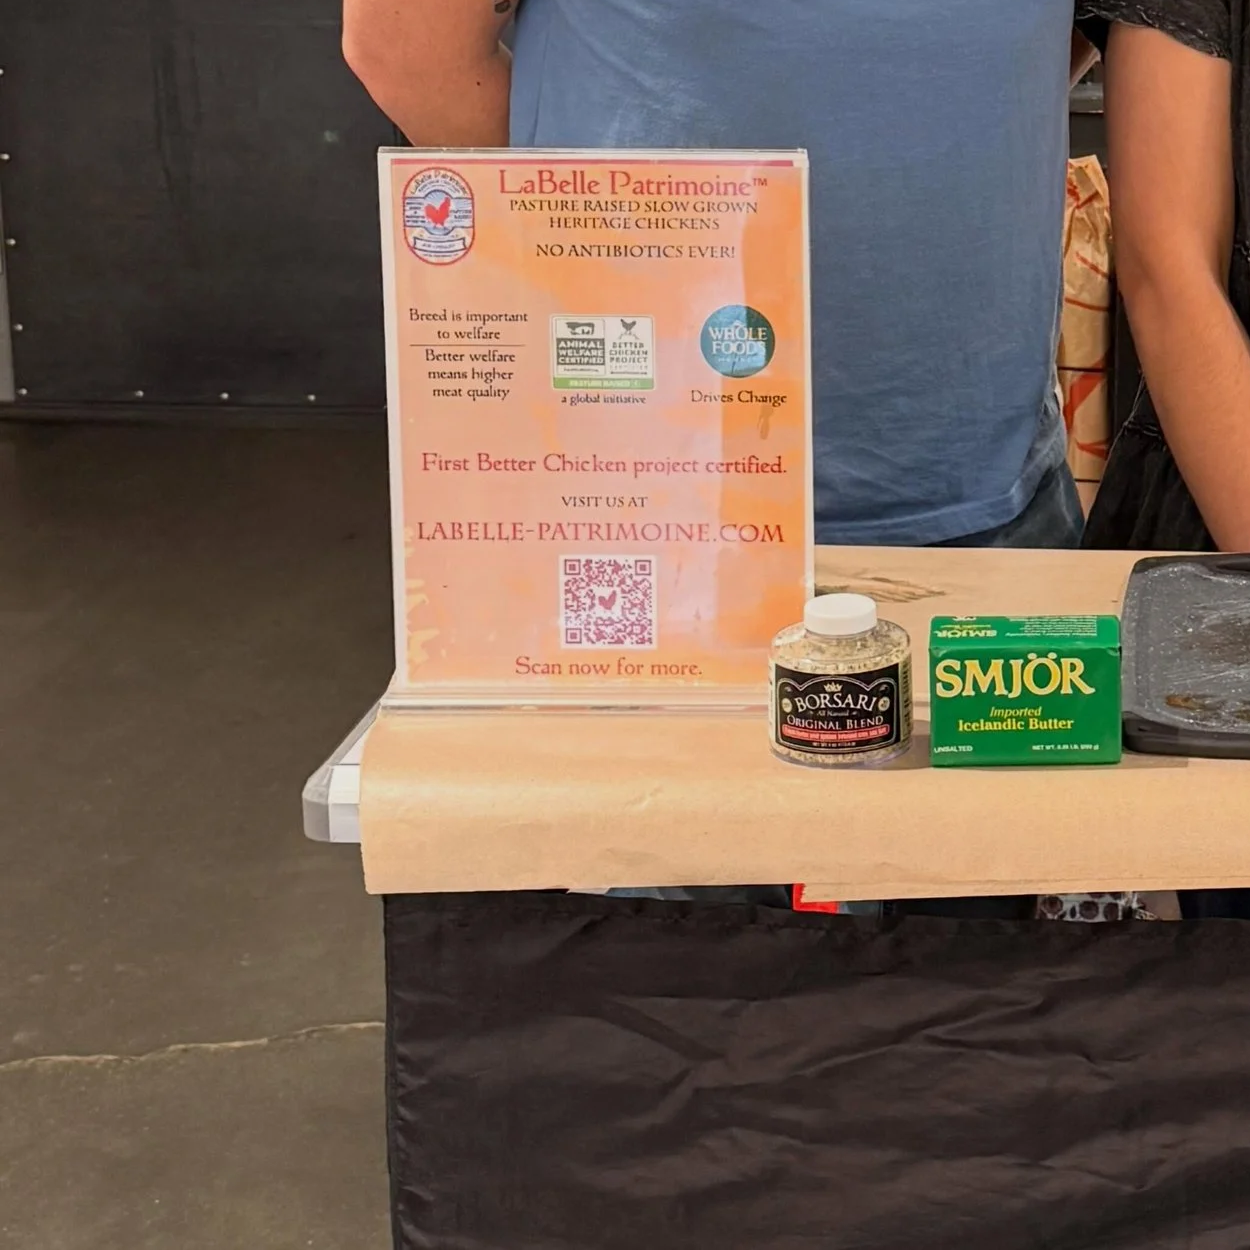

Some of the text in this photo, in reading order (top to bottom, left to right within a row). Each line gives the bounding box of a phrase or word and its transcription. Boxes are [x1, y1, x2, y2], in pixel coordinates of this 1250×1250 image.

[499, 170, 599, 196] LaBelle
[510, 199, 758, 214] PASTURE RAISED SLOW GROWN
[549, 217, 720, 230] HERITAGE CHICKENS
[536, 244, 735, 259] NO ANTIBIOTICS EVER!
[409, 308, 528, 326] Breed is important
[437, 326, 500, 340] to welfare
[708, 326, 768, 340] WHOLE
[559, 341, 603, 349] ANIMAL
[711, 341, 767, 355] FOODS
[425, 349, 515, 363] Better welfare
[559, 349, 604, 357] WELFARE
[428, 367, 514, 385] means higher
[433, 385, 509, 400] meat quality
[570, 393, 600, 406] global
[603, 394, 646, 403] initiative
[691, 389, 787, 407] Drives Change
[422, 452, 787, 478] First Better Chicken project certified.
[561, 495, 648, 508] VISIT US AT
[417, 521, 785, 543] LABELLE-PATRIMOINE.COM
[515, 656, 702, 676] Scan now for more.
[935, 652, 1096, 699] SMJÖR
[794, 692, 877, 713] BORSARI
[989, 706, 1042, 718] Imported
[786, 714, 884, 730] ORIGINAL BLEND
[958, 717, 1074, 731] Icelandic Butter
[934, 745, 973, 754] UNSALTED
